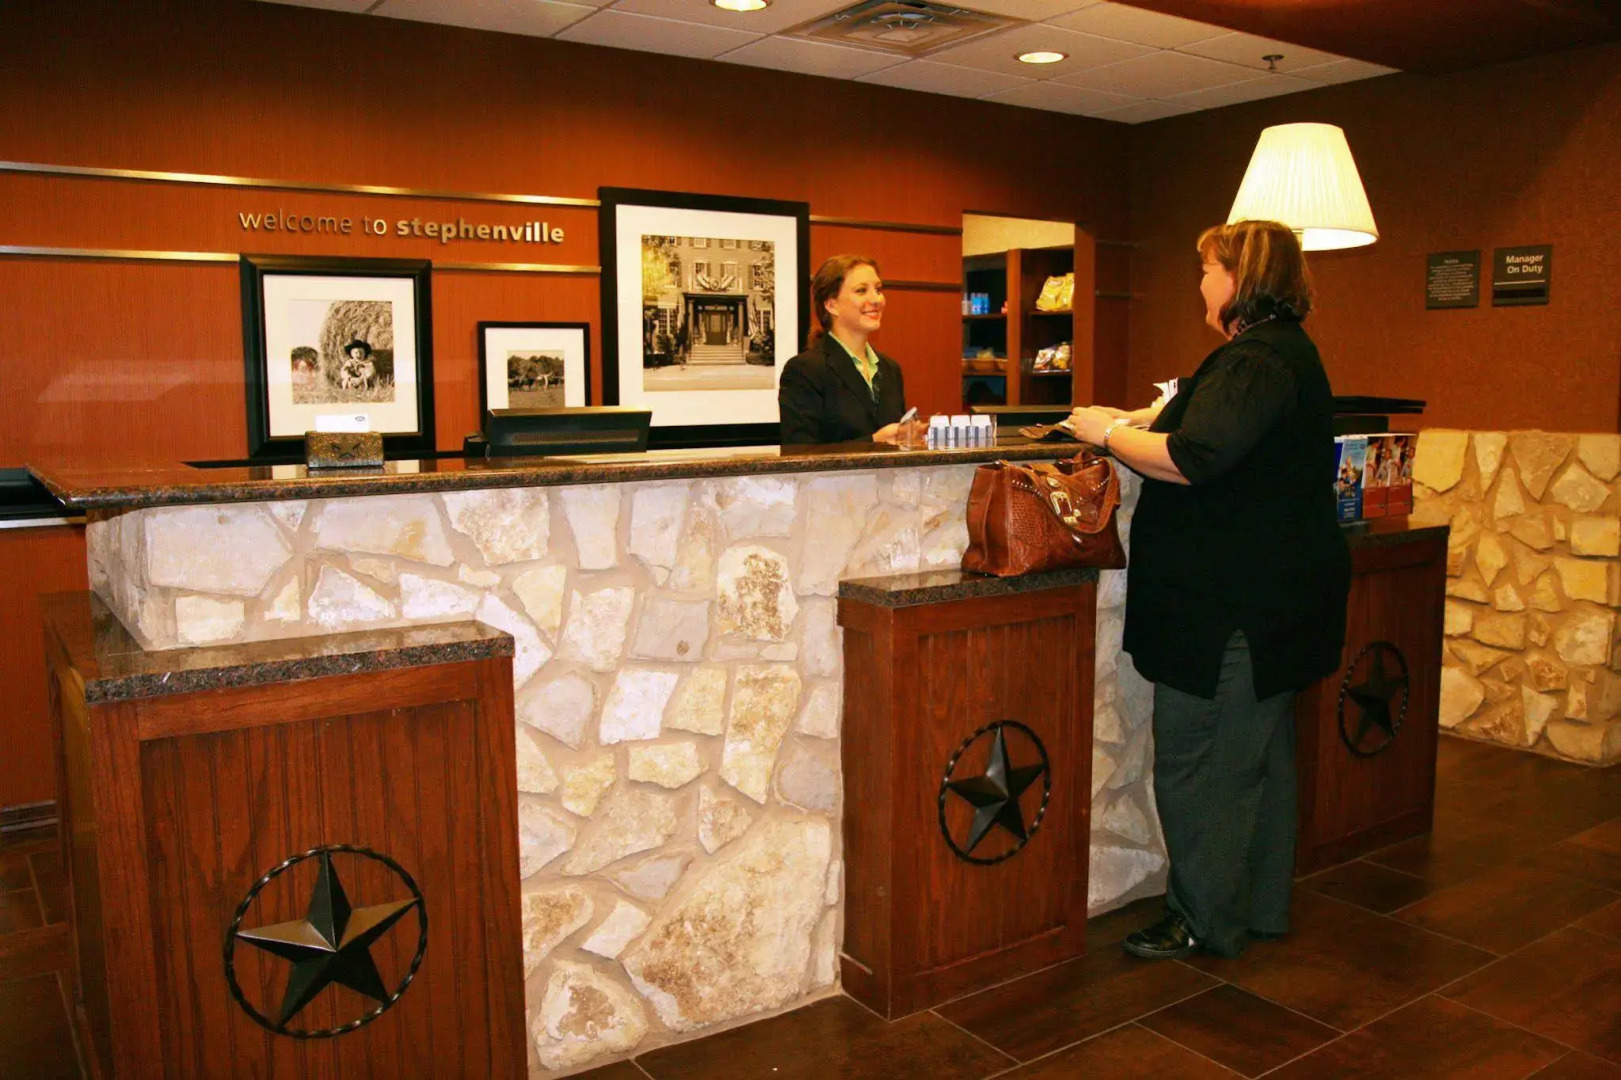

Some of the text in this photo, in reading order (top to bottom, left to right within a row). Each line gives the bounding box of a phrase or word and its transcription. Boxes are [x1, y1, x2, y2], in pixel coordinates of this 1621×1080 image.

[239, 208, 565, 243] welcome to stephenville
[1506, 254, 1544, 264] Manager
[1507, 264, 1543, 274] On Duty
